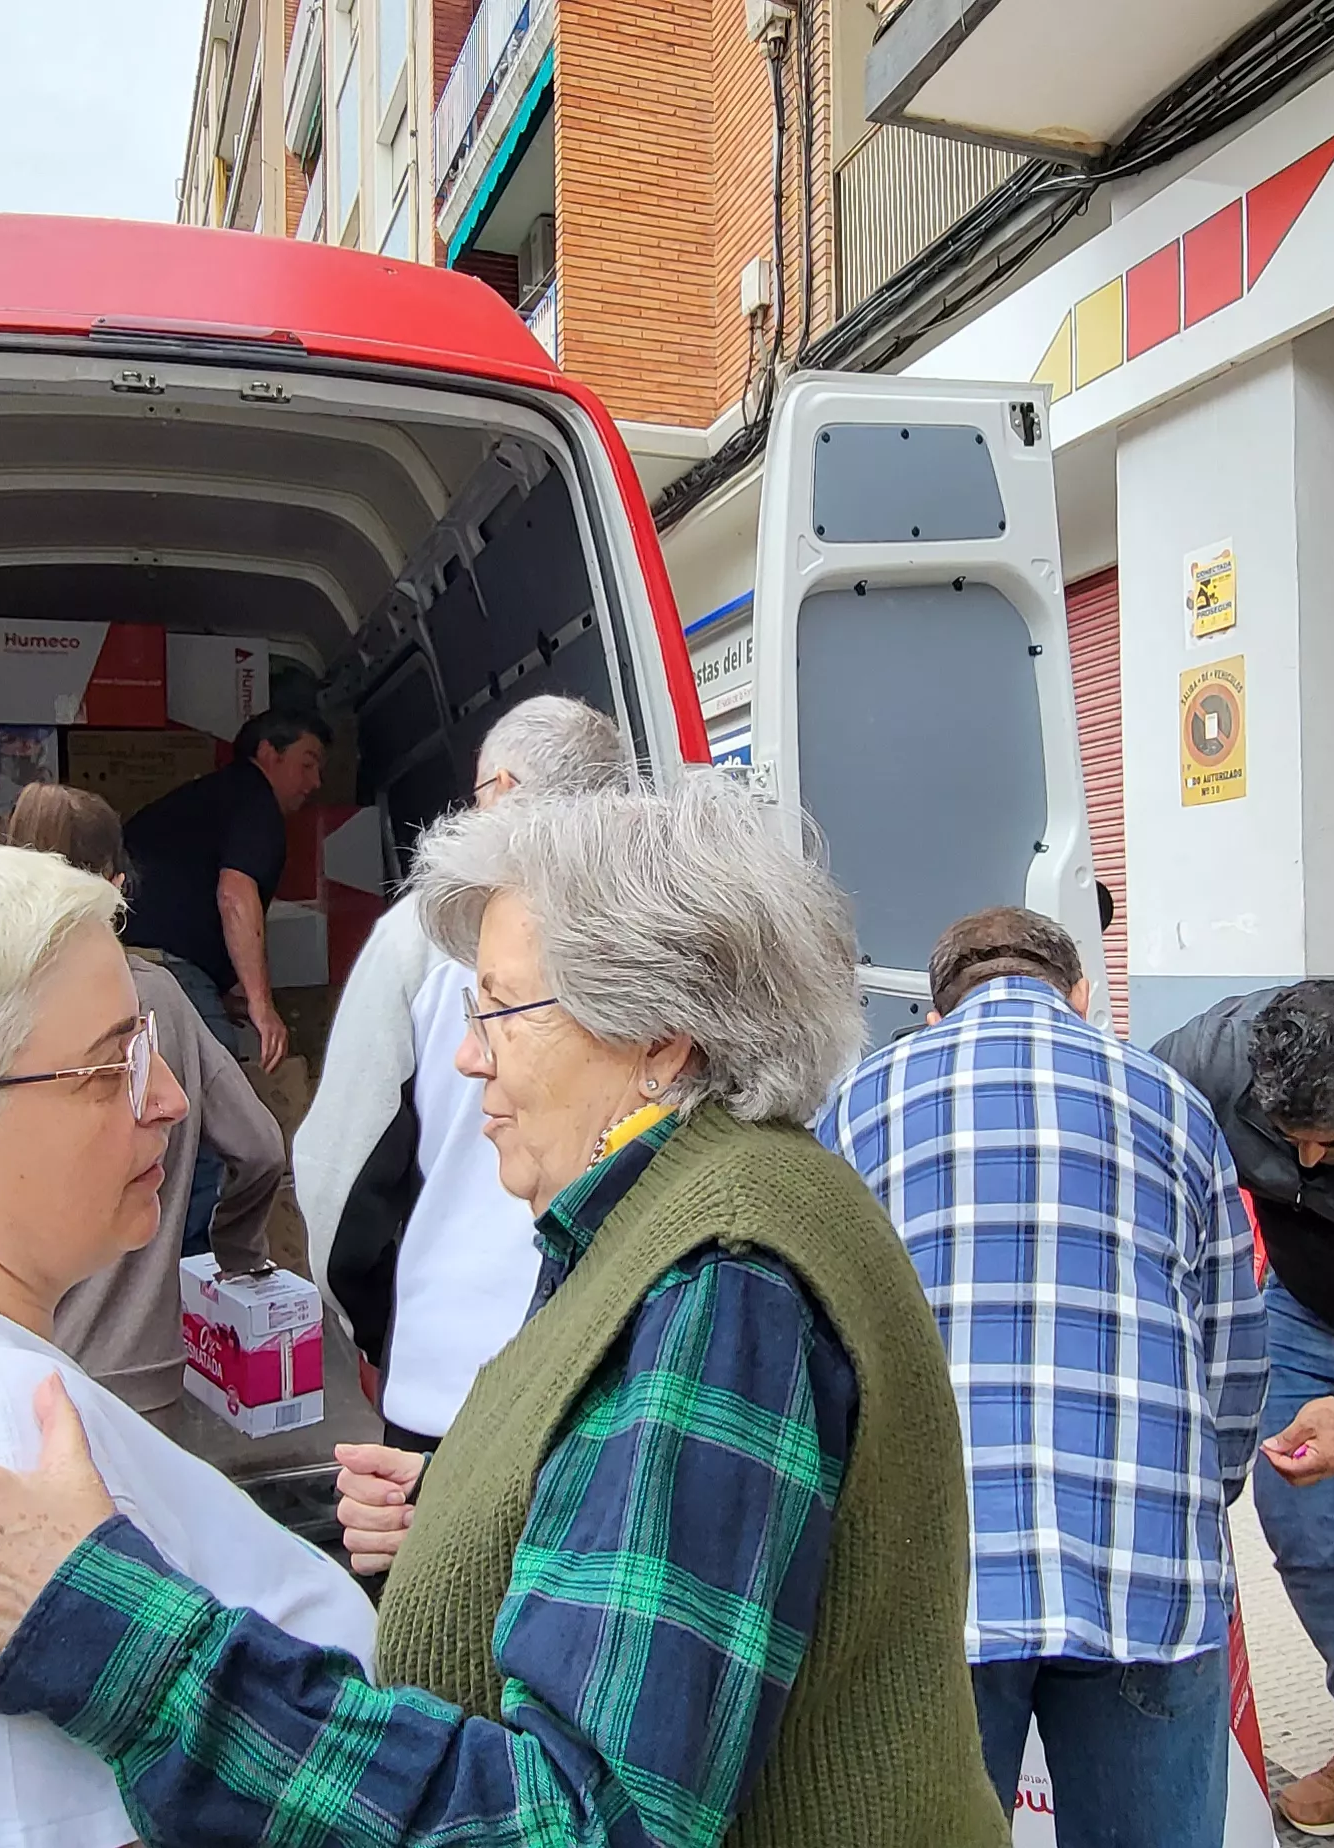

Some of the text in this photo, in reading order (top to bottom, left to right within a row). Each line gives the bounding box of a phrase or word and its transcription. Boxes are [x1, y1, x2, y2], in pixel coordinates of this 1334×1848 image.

[1196, 601, 1232, 619] PROSEGUR
[4, 632, 81, 649] Humeco
[693, 658, 720, 687] stas
[724, 641, 742, 676] del
[1203, 768, 1243, 784] AUTORIZADO
